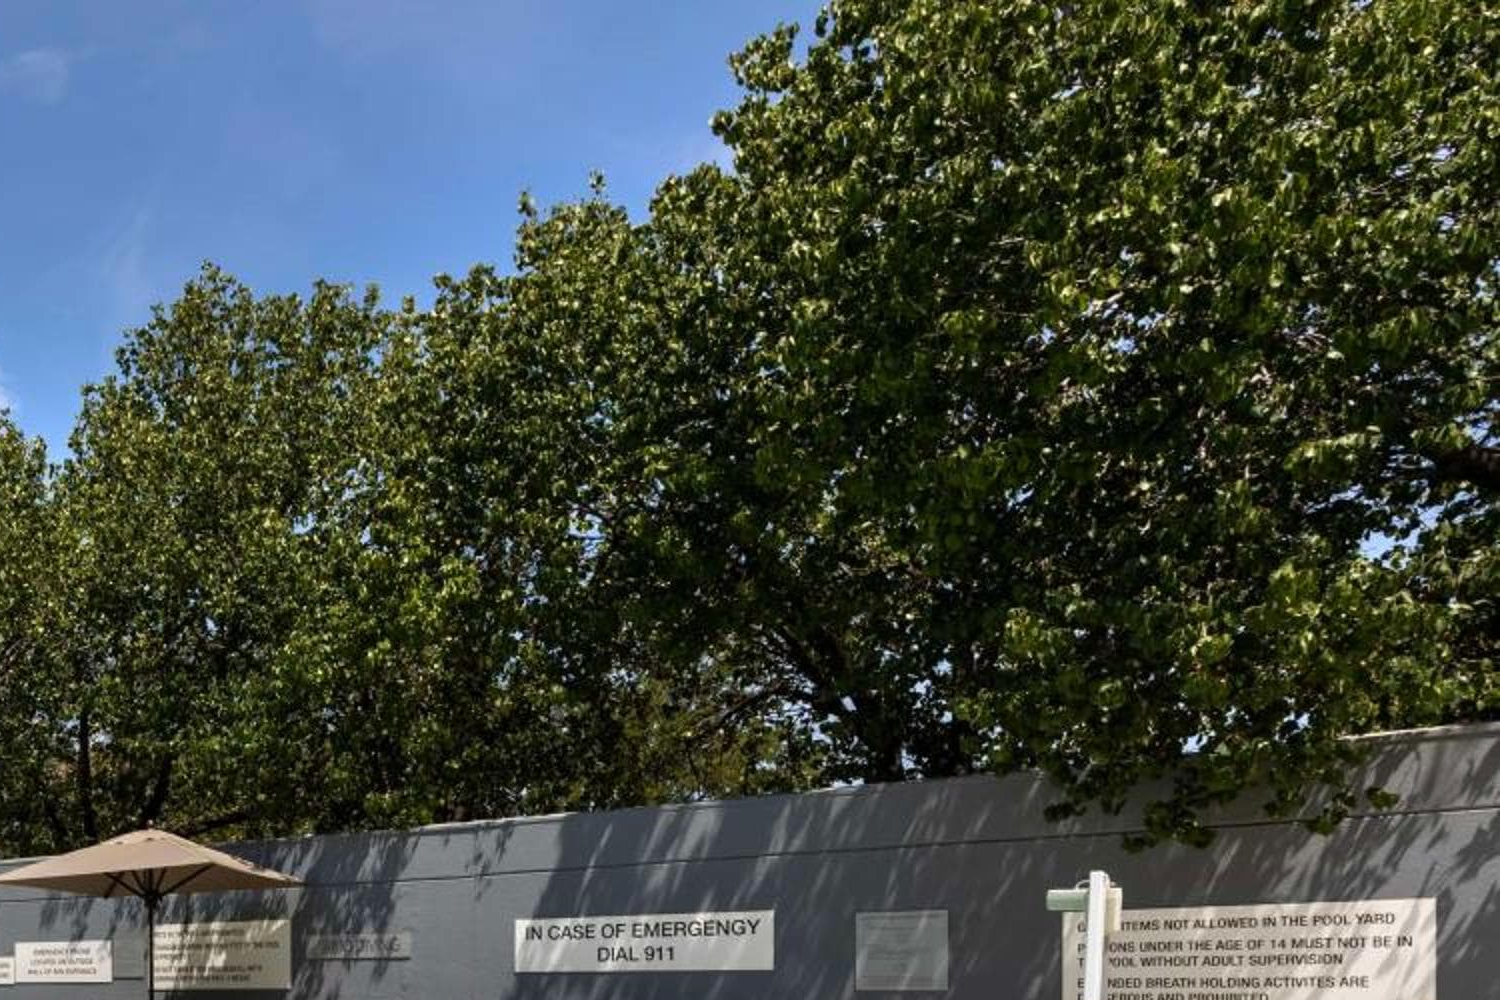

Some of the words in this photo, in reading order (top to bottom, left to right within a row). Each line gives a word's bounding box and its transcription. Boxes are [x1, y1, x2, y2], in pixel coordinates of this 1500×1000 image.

[1164, 919, 1189, 930] NOT
[1192, 917, 1258, 930] ALLOWED
[1263, 916, 1277, 928] IN
[1281, 915, 1309, 927] THE
[1313, 913, 1353, 926] POOL
[1355, 912, 1396, 925] YARD
[525, 925, 543, 941] IN
[547, 923, 595, 940] CASE
[601, 923, 626, 939] OF
[1139, 940, 1184, 952] UNDER
[1187, 940, 1212, 951] THE
[1215, 939, 1244, 951] AGE
[1247, 939, 1265, 950] OF
[1271, 939, 1287, 949] 14
[1291, 938, 1332, 949] MUST
[1337, 937, 1366, 949] NOT
[1373, 936, 1393, 948] BE
[1397, 935, 1413, 947] IN
[597, 946, 639, 962] DIAL
[645, 946, 675, 962] 911
[1140, 955, 1199, 968] WITHOUT
[1201, 955, 1245, 968] ADULT
[1248, 954, 1343, 967] SUPERVISION
[1145, 977, 1196, 989] BREATH
[1199, 977, 1260, 989] HOLDING
[1339, 975, 1369, 988] ARE
